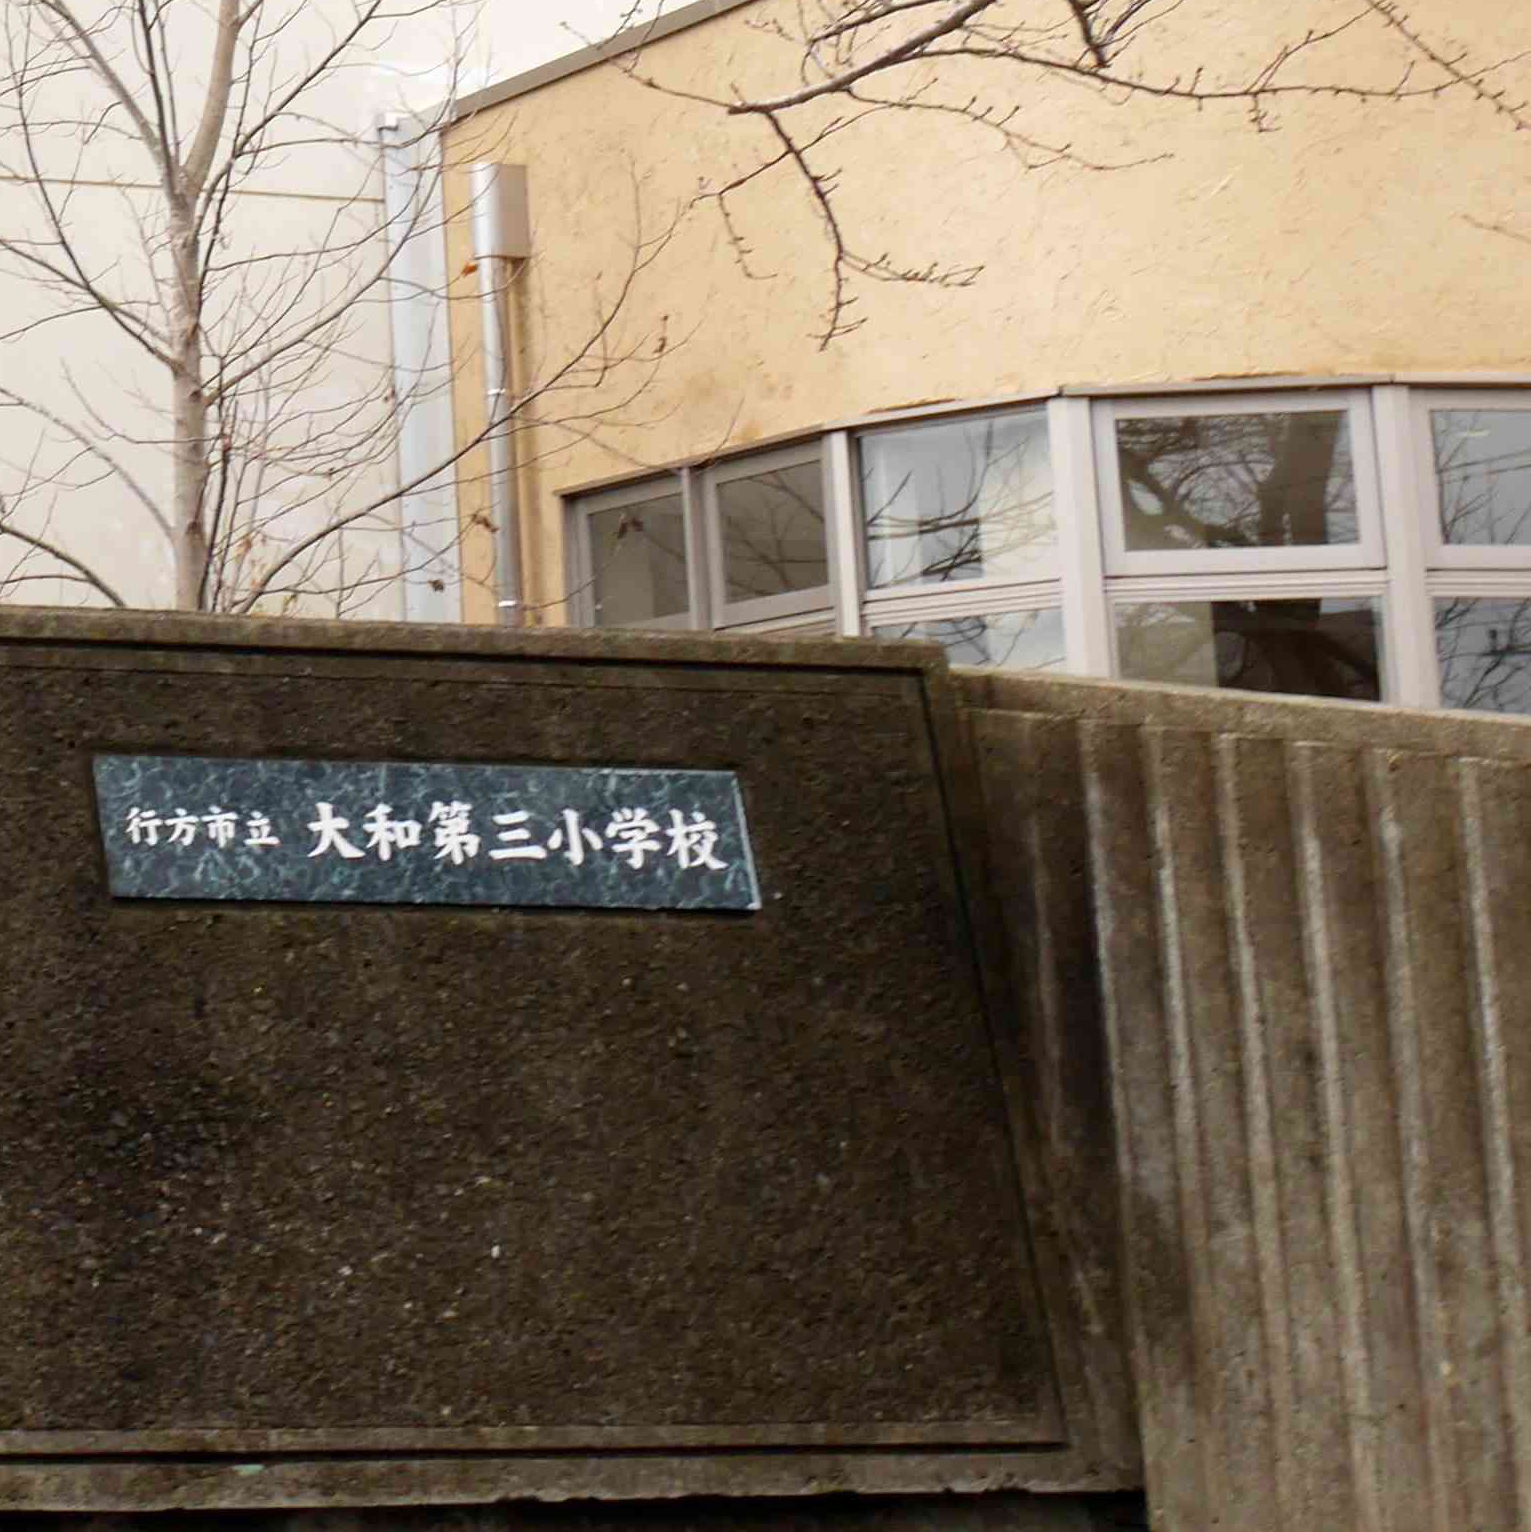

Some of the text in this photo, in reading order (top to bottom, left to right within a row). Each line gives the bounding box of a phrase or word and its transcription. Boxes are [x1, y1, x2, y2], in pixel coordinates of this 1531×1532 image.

[125, 800, 729, 870] 行方市立 大和第三小学校
